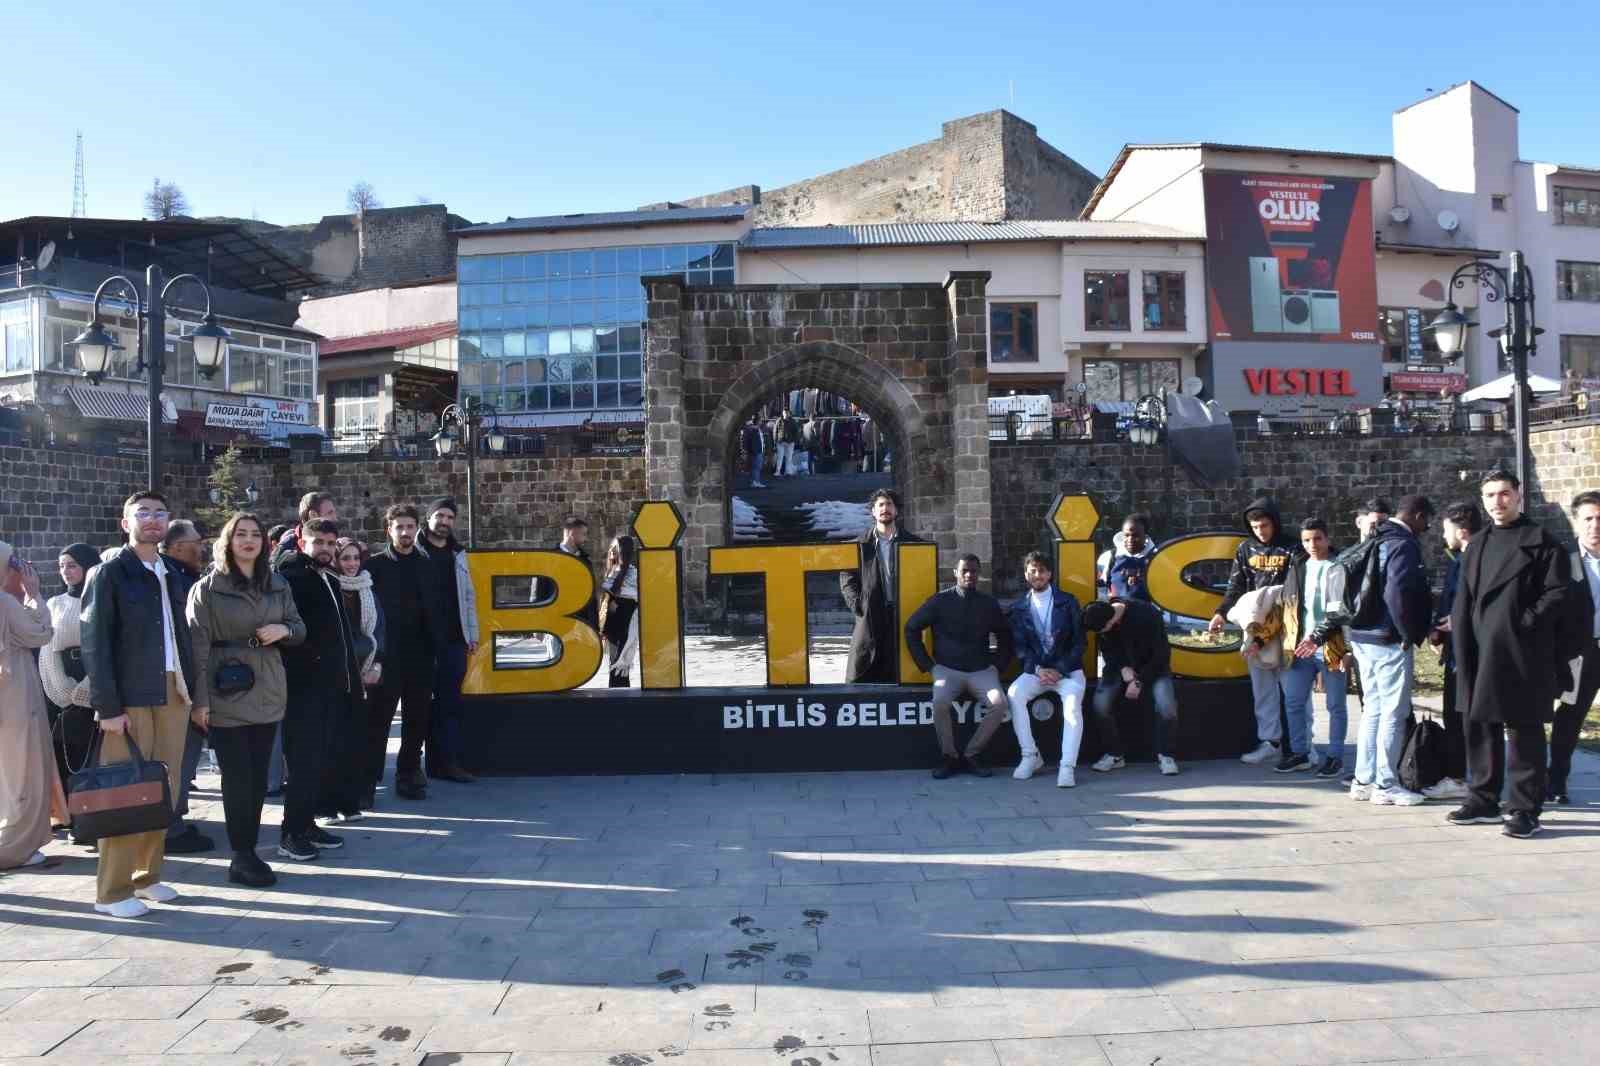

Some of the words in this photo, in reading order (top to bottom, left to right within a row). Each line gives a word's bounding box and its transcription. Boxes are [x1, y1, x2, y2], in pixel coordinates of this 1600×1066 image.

[1259, 199, 1320, 220] OLUR
[1351, 331, 1375, 340] VESTEL
[1243, 367, 1358, 397] VESTEL
[212, 405, 240, 416] MODA
[722, 697, 828, 729] BİTLİS
